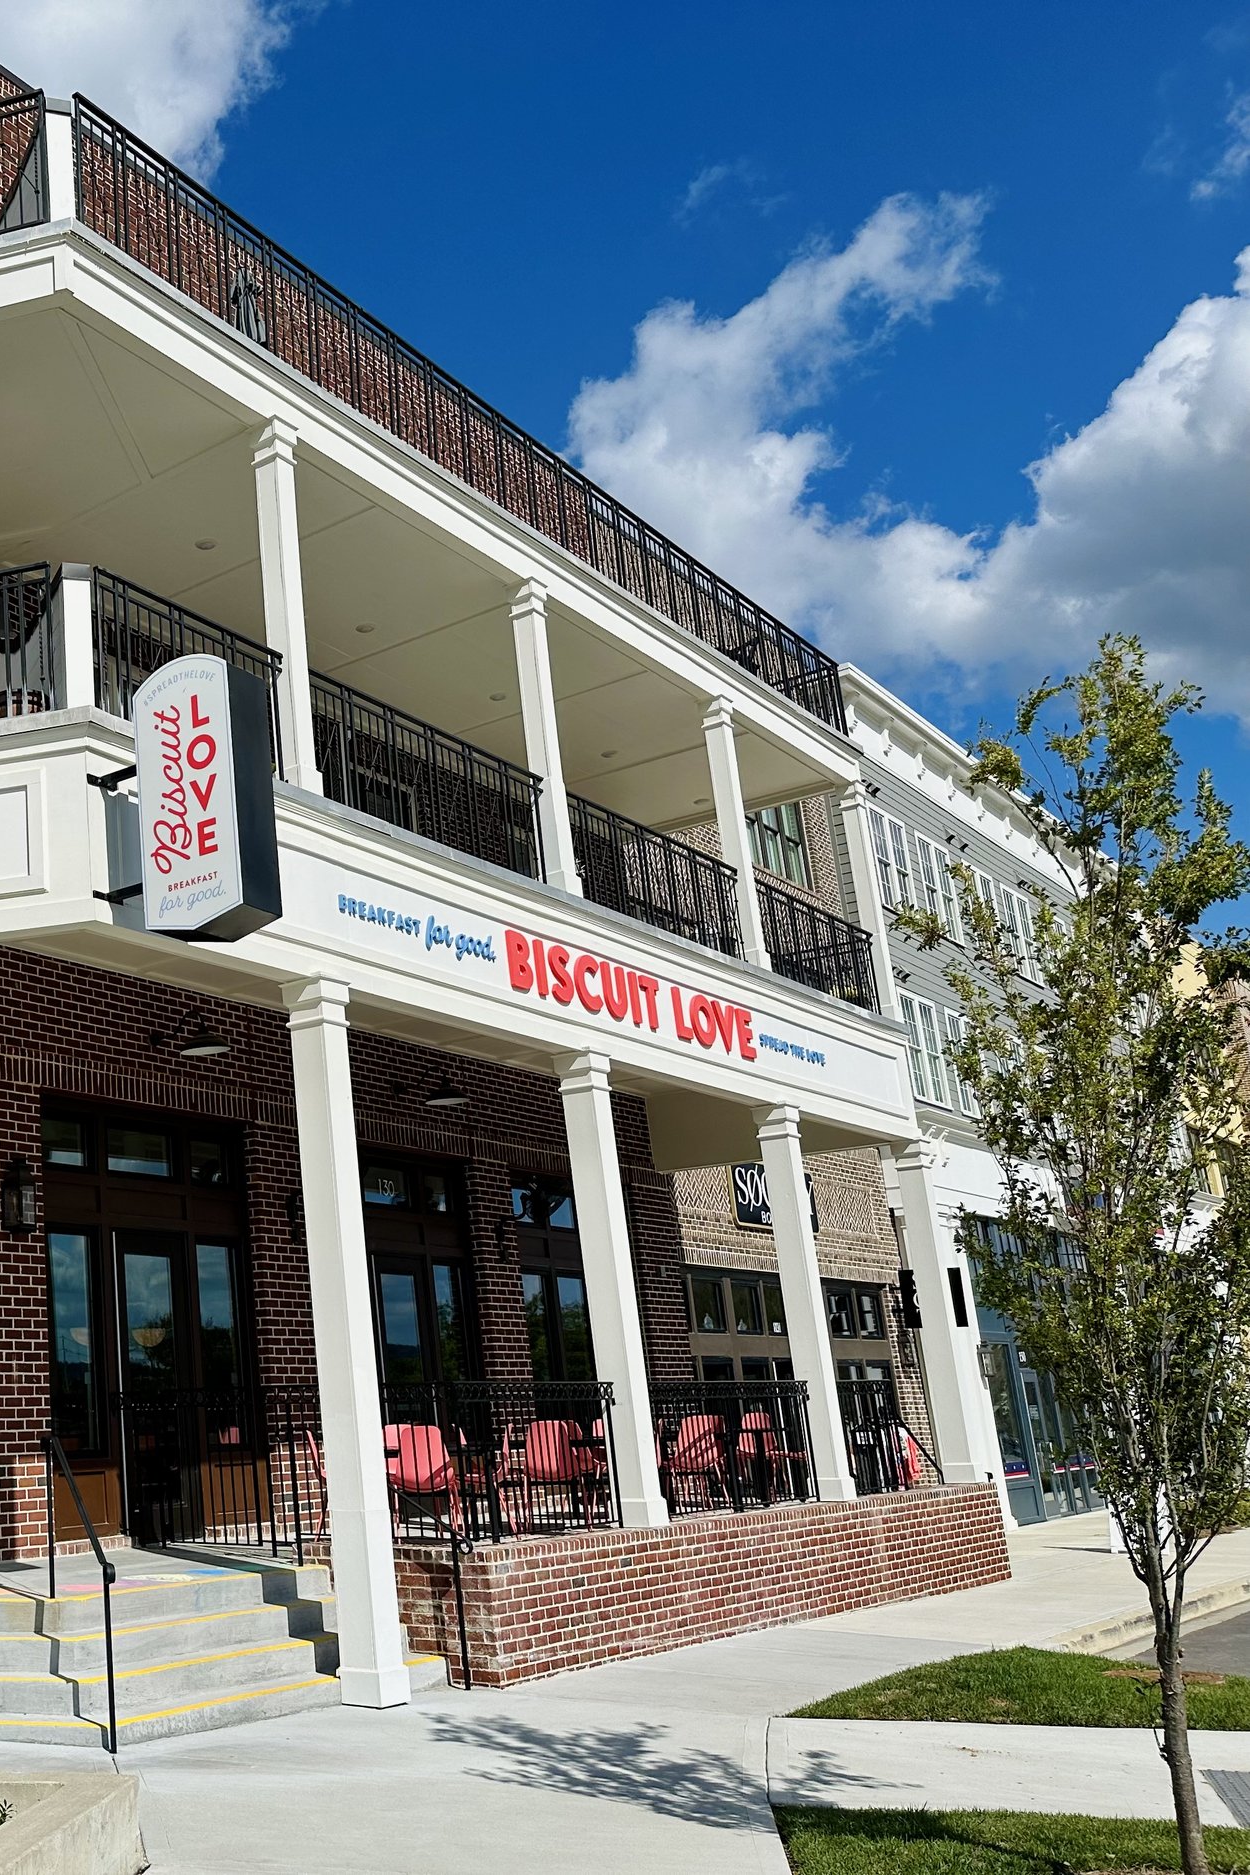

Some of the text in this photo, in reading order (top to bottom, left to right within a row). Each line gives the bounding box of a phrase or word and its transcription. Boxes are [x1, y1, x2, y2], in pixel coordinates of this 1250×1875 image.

[143, 671, 216, 707] #SPREADTHELOVE
[150, 704, 193, 875] Biscuit
[187, 694, 219, 857] LOVE
[167, 870, 218, 893] BREAKFAST
[158, 895, 184, 919] for
[337, 893, 422, 938] BREAKFAST
[424, 914, 455, 952] for
[504, 929, 660, 1033] BISCUIT
[670, 986, 758, 1063] LOVE
[759, 1033, 790, 1056] SPREAD
[789, 1043, 806, 1061] THE
[805, 1048, 826, 1068] LOVE
[378, 1178, 395, 1197] 130
